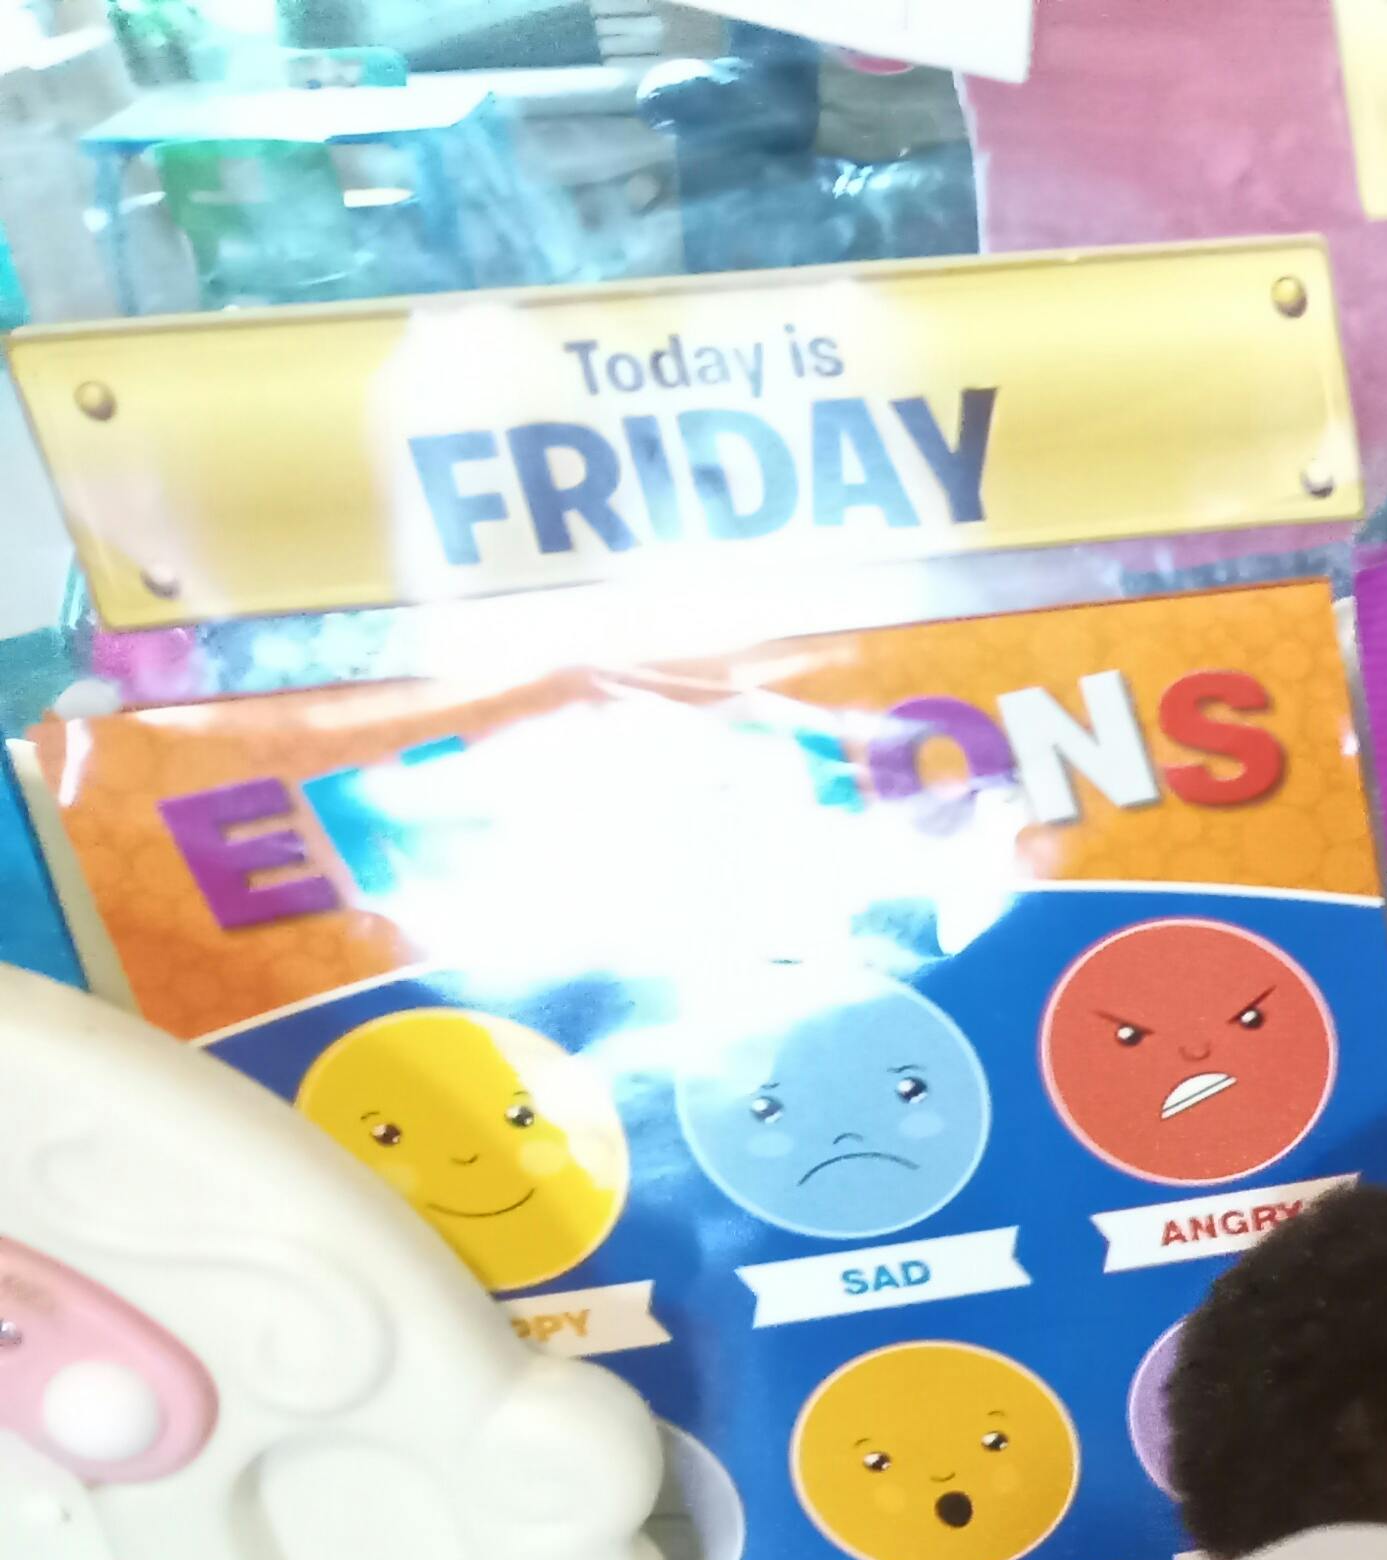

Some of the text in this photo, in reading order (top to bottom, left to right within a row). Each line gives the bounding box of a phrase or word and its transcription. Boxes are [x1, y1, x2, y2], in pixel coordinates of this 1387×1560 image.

[564, 323, 845, 399] Today is
[407, 387, 998, 567] FRIDAY
[841, 1259, 931, 1296] SAD
